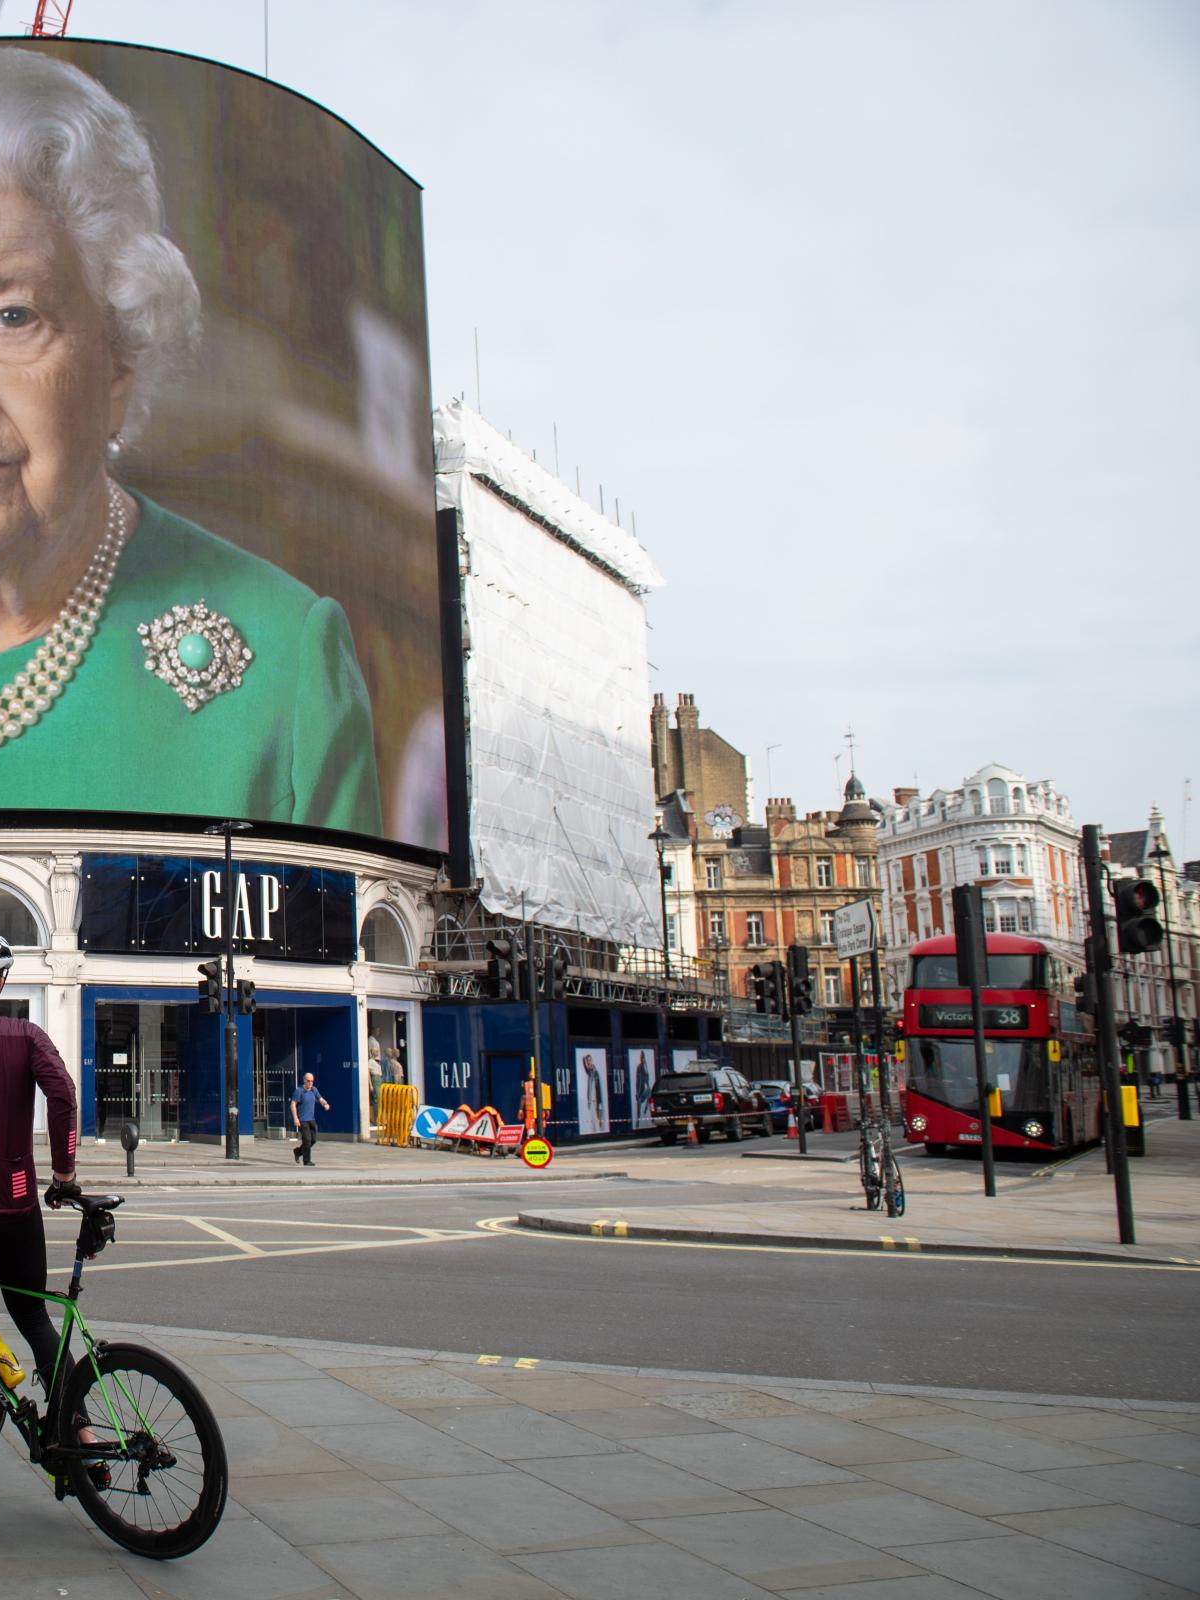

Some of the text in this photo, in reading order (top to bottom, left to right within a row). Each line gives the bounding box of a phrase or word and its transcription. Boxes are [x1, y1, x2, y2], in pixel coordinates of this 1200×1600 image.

[202, 870, 280, 941] GAP
[999, 1008, 1021, 1024] 38
[440, 1062, 471, 1089] GAP
[555, 1068, 571, 1096] GAP
[613, 1068, 625, 1095] GAP
